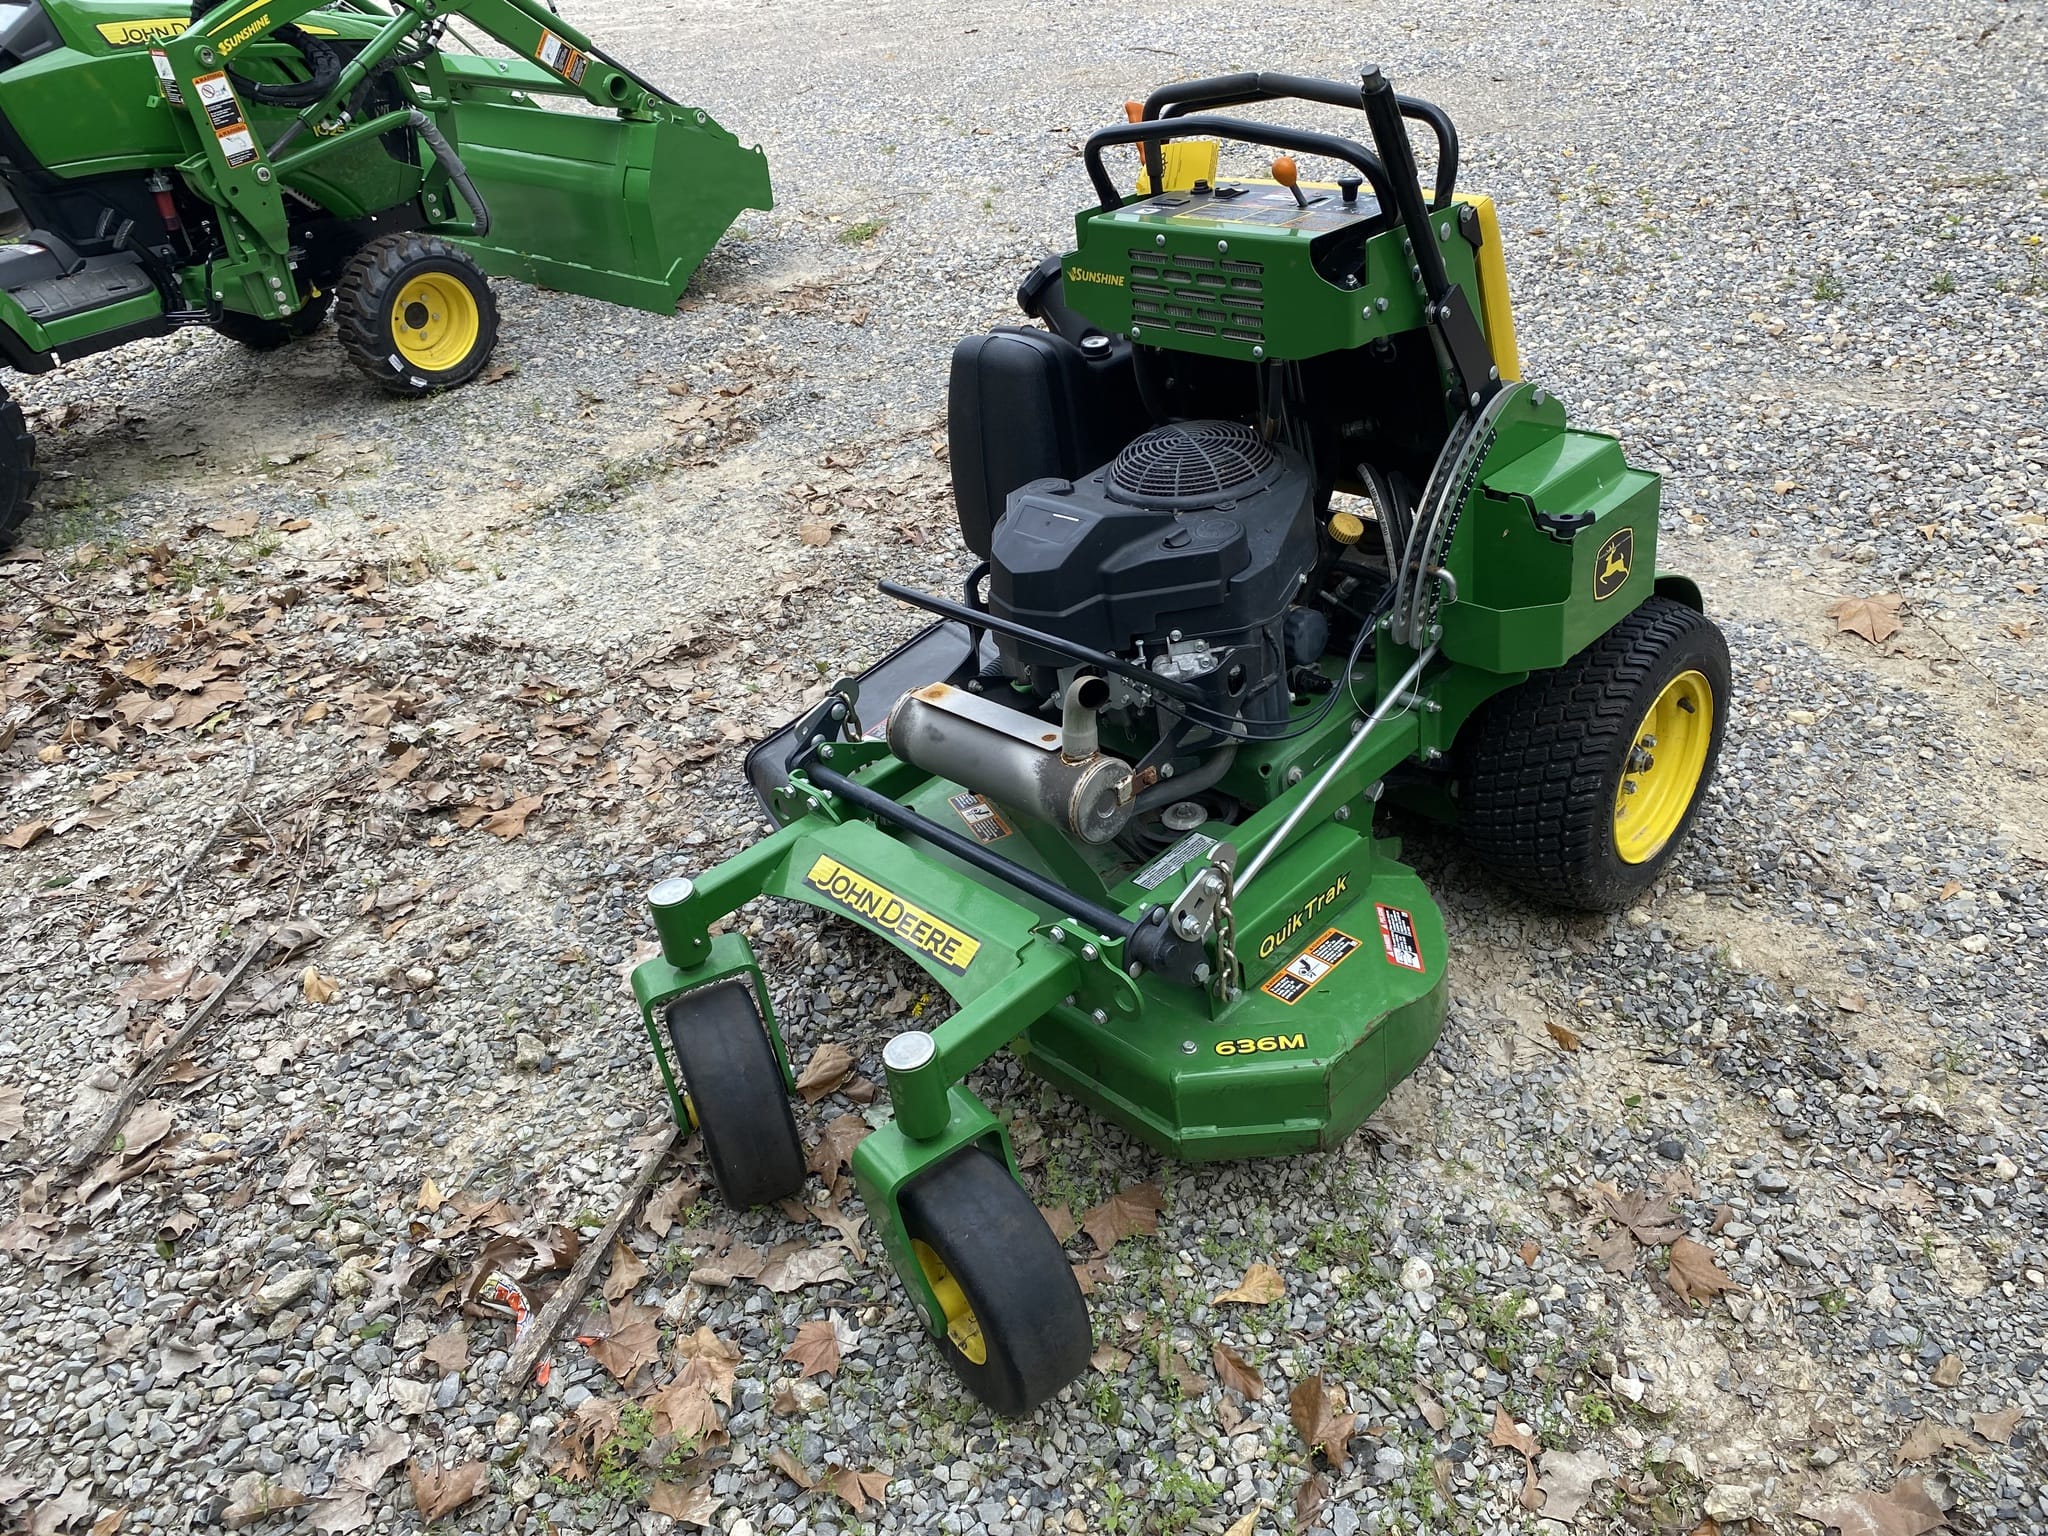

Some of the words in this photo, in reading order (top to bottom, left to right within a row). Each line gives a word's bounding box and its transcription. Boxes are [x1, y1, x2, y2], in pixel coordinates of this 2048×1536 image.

[119, 25, 169, 43] JOHN
[225, 13, 271, 52] SUNSHINE
[1075, 267, 1125, 287] SUNSHINE
[816, 866, 883, 916] JOHN
[878, 898, 963, 961] DEERE
[1215, 1033, 1306, 1056] 636M
